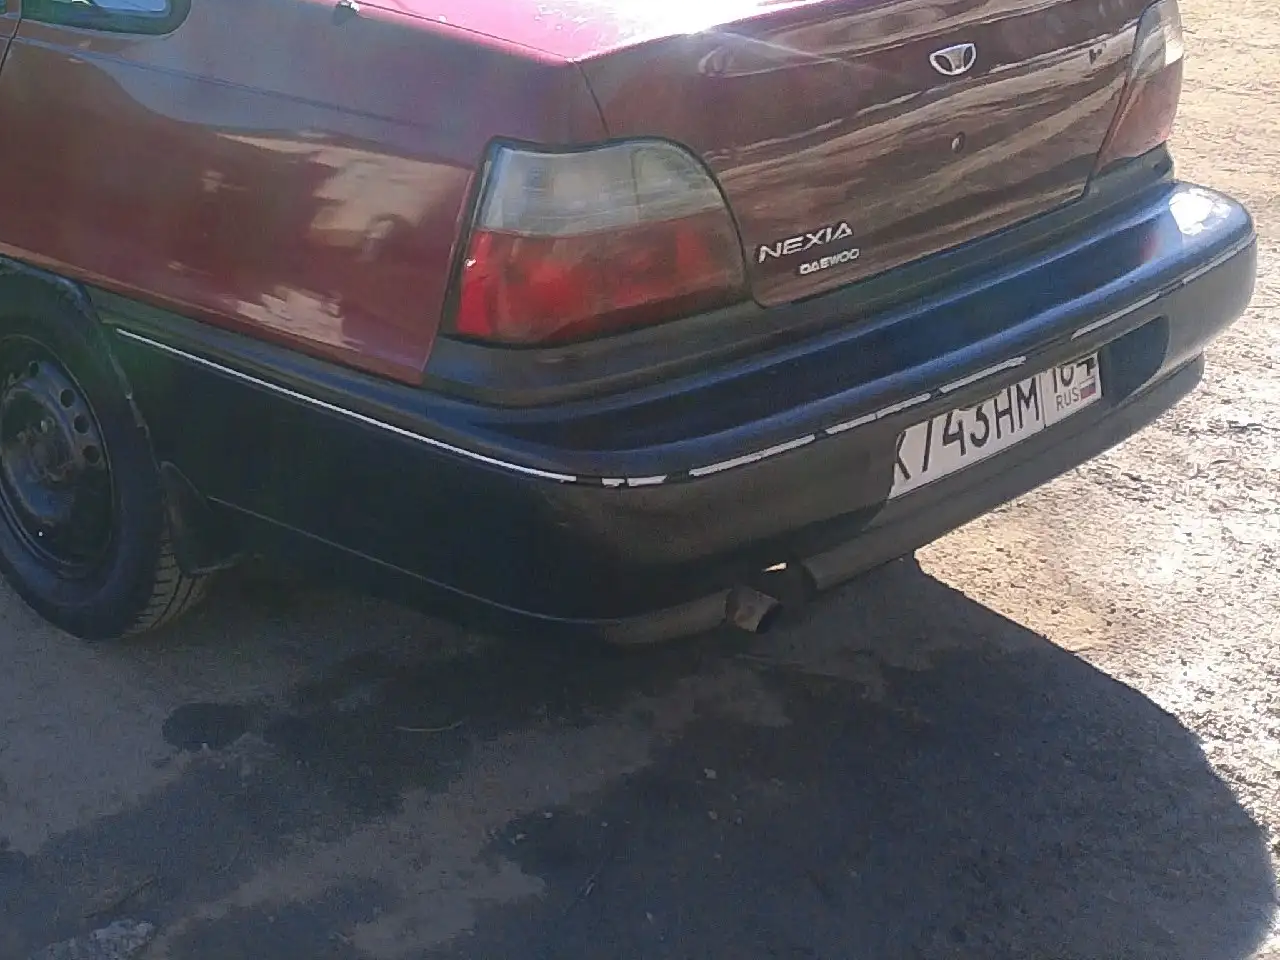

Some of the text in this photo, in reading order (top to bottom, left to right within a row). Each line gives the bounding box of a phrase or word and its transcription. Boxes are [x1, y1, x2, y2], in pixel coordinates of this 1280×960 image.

[758, 222, 853, 264] NEXIA
[799, 248, 860, 275] DAEWOO
[1055, 386, 1080, 412] RUS
